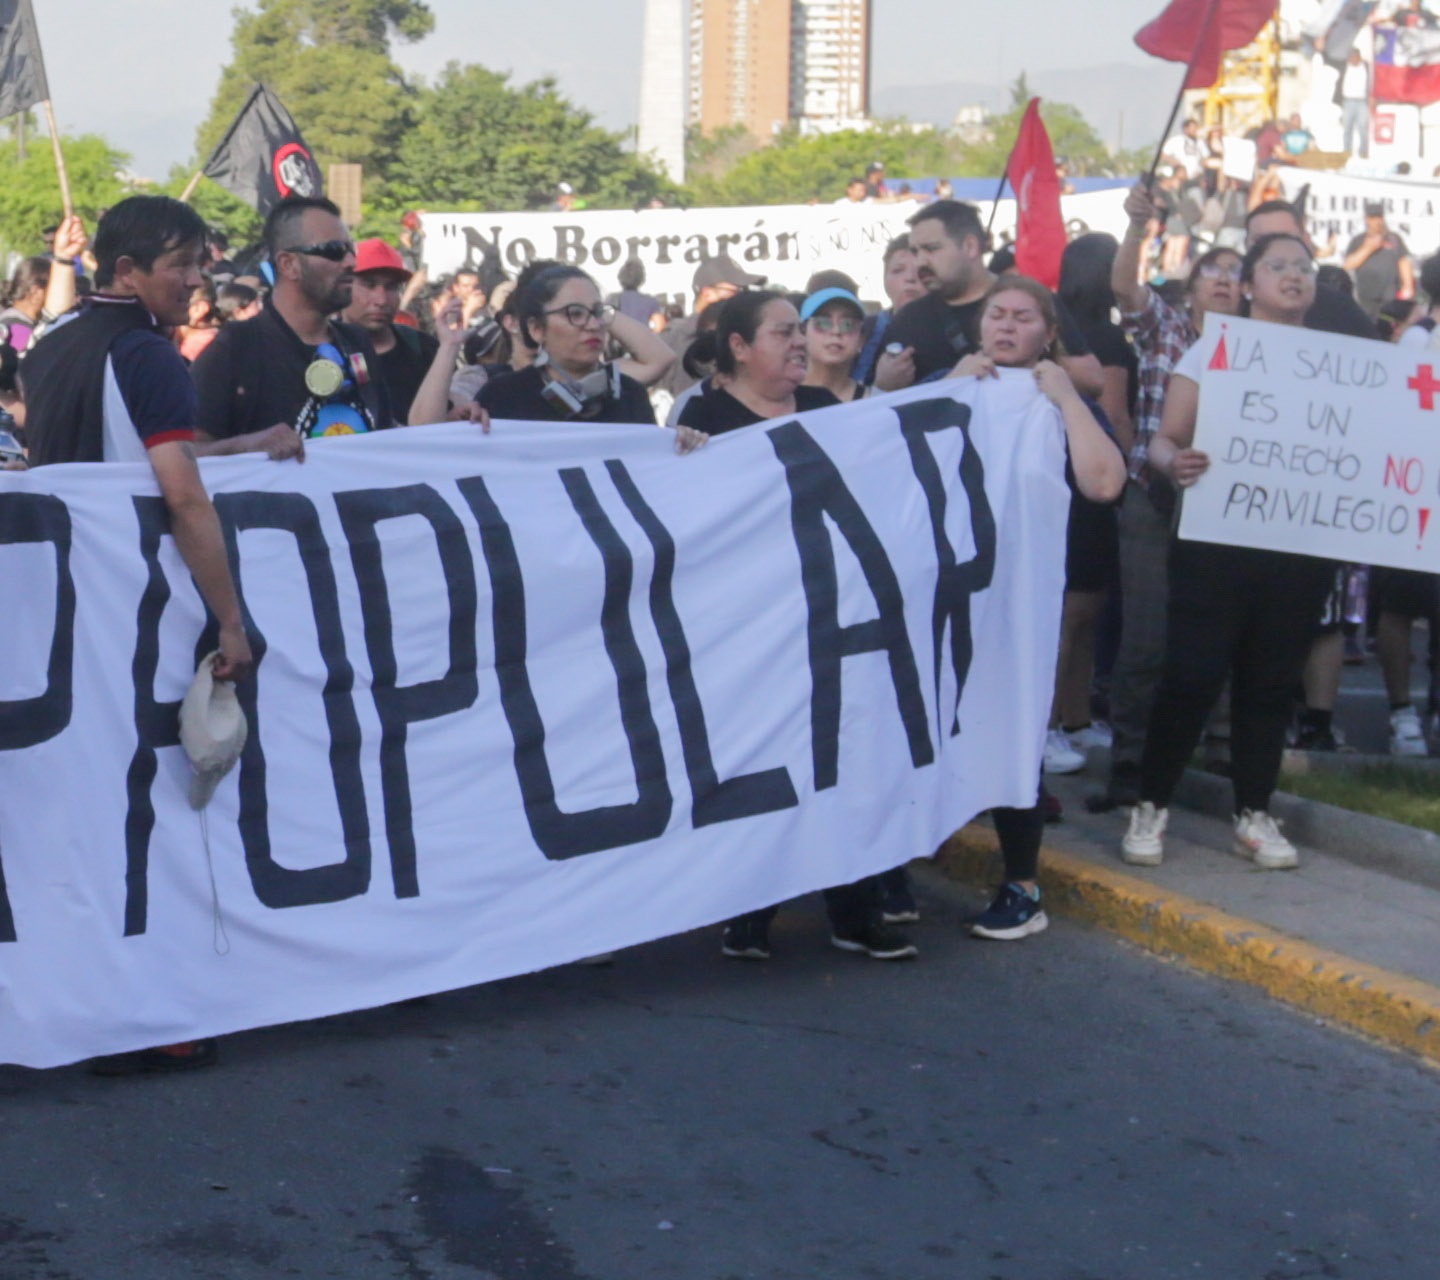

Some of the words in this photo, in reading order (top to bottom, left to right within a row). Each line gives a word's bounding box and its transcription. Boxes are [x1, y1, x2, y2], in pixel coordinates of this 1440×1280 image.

[552, 219, 799, 266] Borrarán
[1294, 349, 1388, 389] SALUD
[1240, 391, 1279, 424] ES
[1307, 401, 1351, 437] UN
[1222, 436, 1361, 482] DERECHO
[1383, 453, 1425, 496] NO
[123, 396, 997, 937] POPULAR
